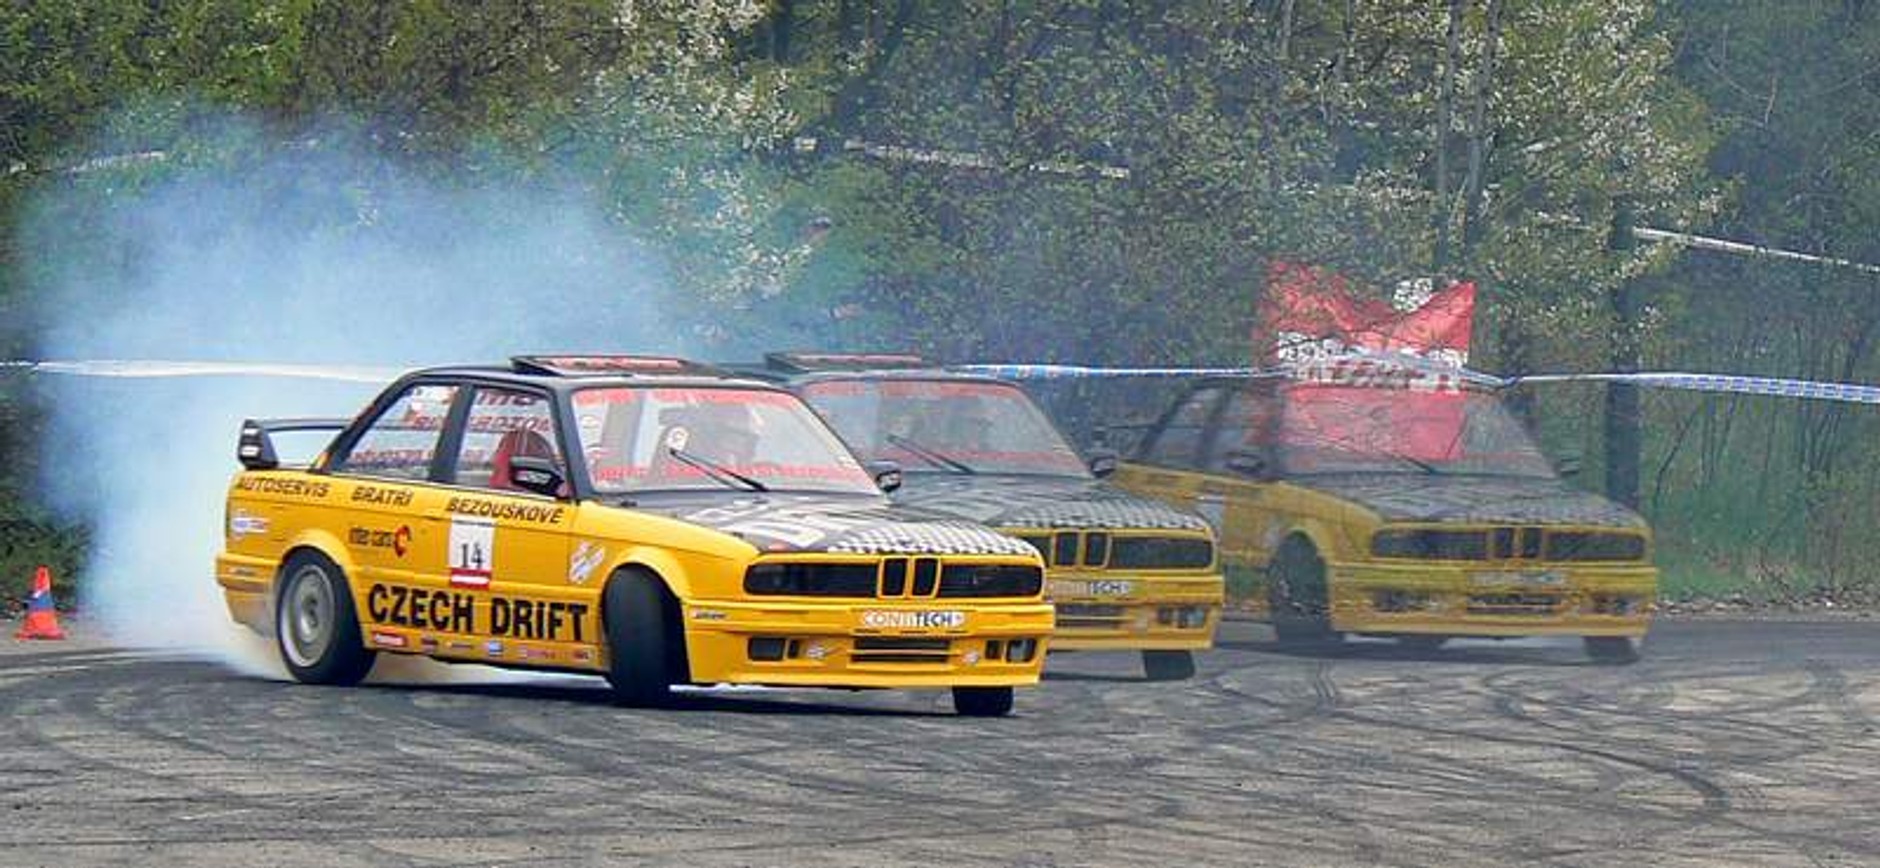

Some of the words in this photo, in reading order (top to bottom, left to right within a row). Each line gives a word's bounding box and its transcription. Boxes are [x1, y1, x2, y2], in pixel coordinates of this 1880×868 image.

[234, 475, 329, 499] AUTOSERVIS
[461, 541, 484, 569] 14
[368, 582, 473, 635] CZECH
